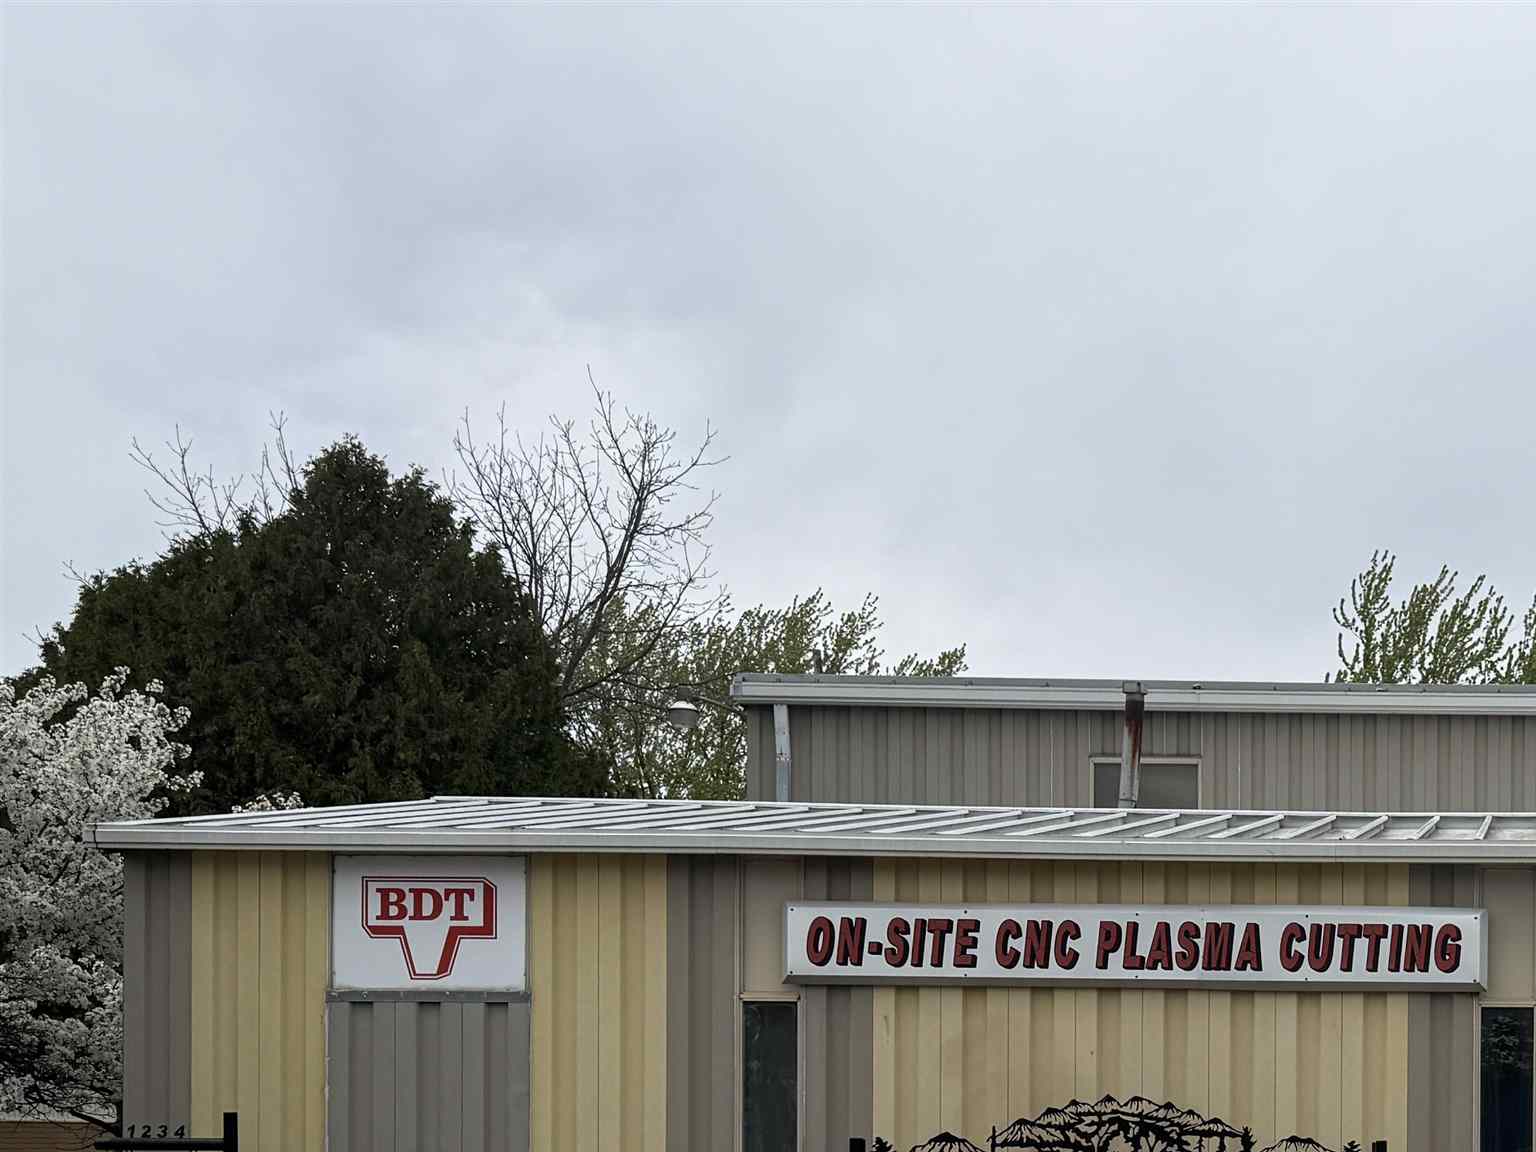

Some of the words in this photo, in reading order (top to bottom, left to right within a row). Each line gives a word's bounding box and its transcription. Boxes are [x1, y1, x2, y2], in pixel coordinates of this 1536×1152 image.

[376, 888, 475, 921] BDT
[806, 916, 980, 967] ON-SITE
[995, 919, 1081, 969] CNC
[1096, 920, 1262, 971] PLASMA
[1280, 923, 1462, 973] CUTTING
[127, 1124, 185, 1139] 1234
